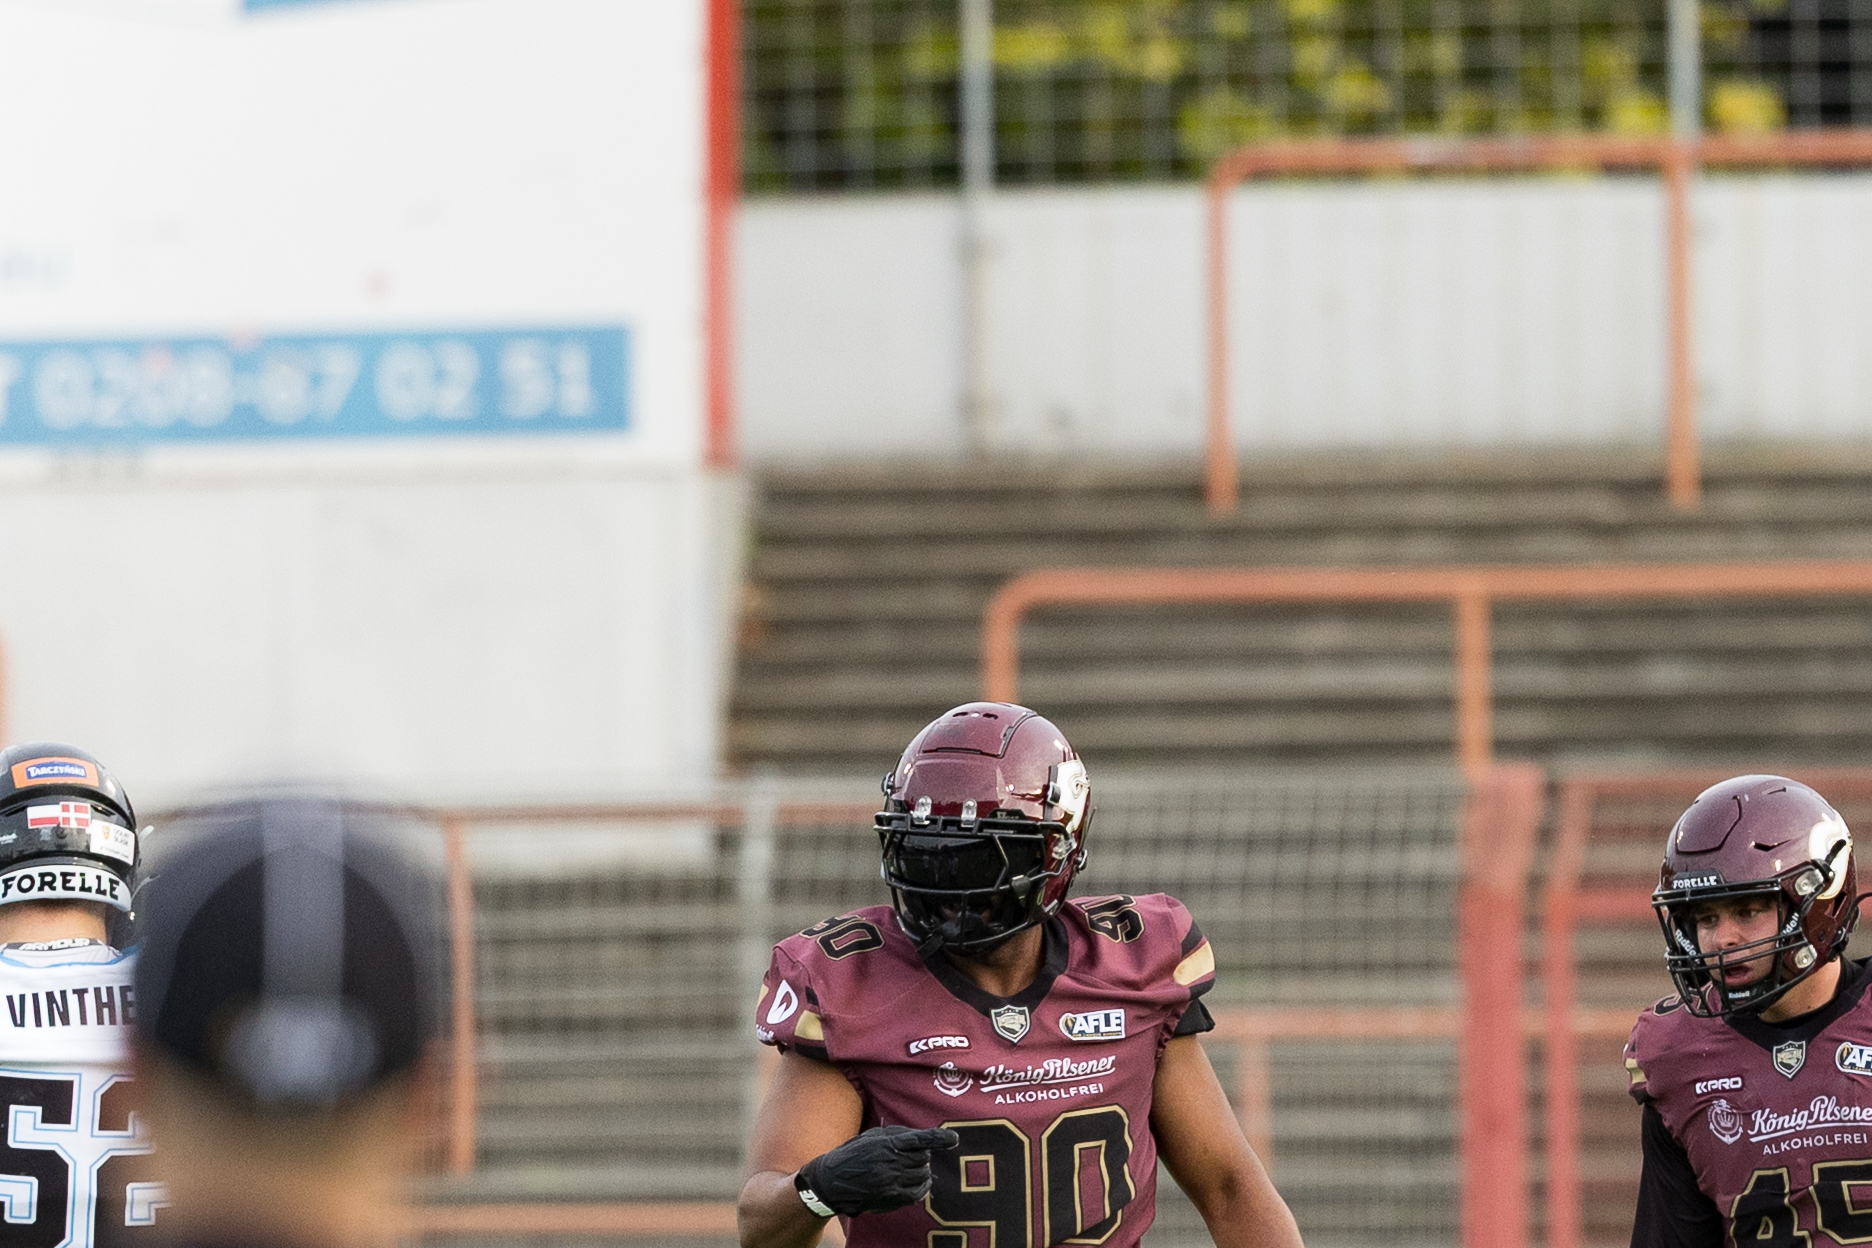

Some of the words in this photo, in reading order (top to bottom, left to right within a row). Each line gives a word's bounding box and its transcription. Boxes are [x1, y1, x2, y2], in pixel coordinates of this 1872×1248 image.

[1, 870, 121, 901] FORELLE
[1673, 875, 1719, 889] FORELLE
[19, 938, 90, 951] ARMOUR
[1072, 1011, 1121, 1034] AFLE
[994, 1083, 1104, 1104] ALKOHOLFREI
[1762, 1132, 1868, 1156] ALKOHOLFREI
